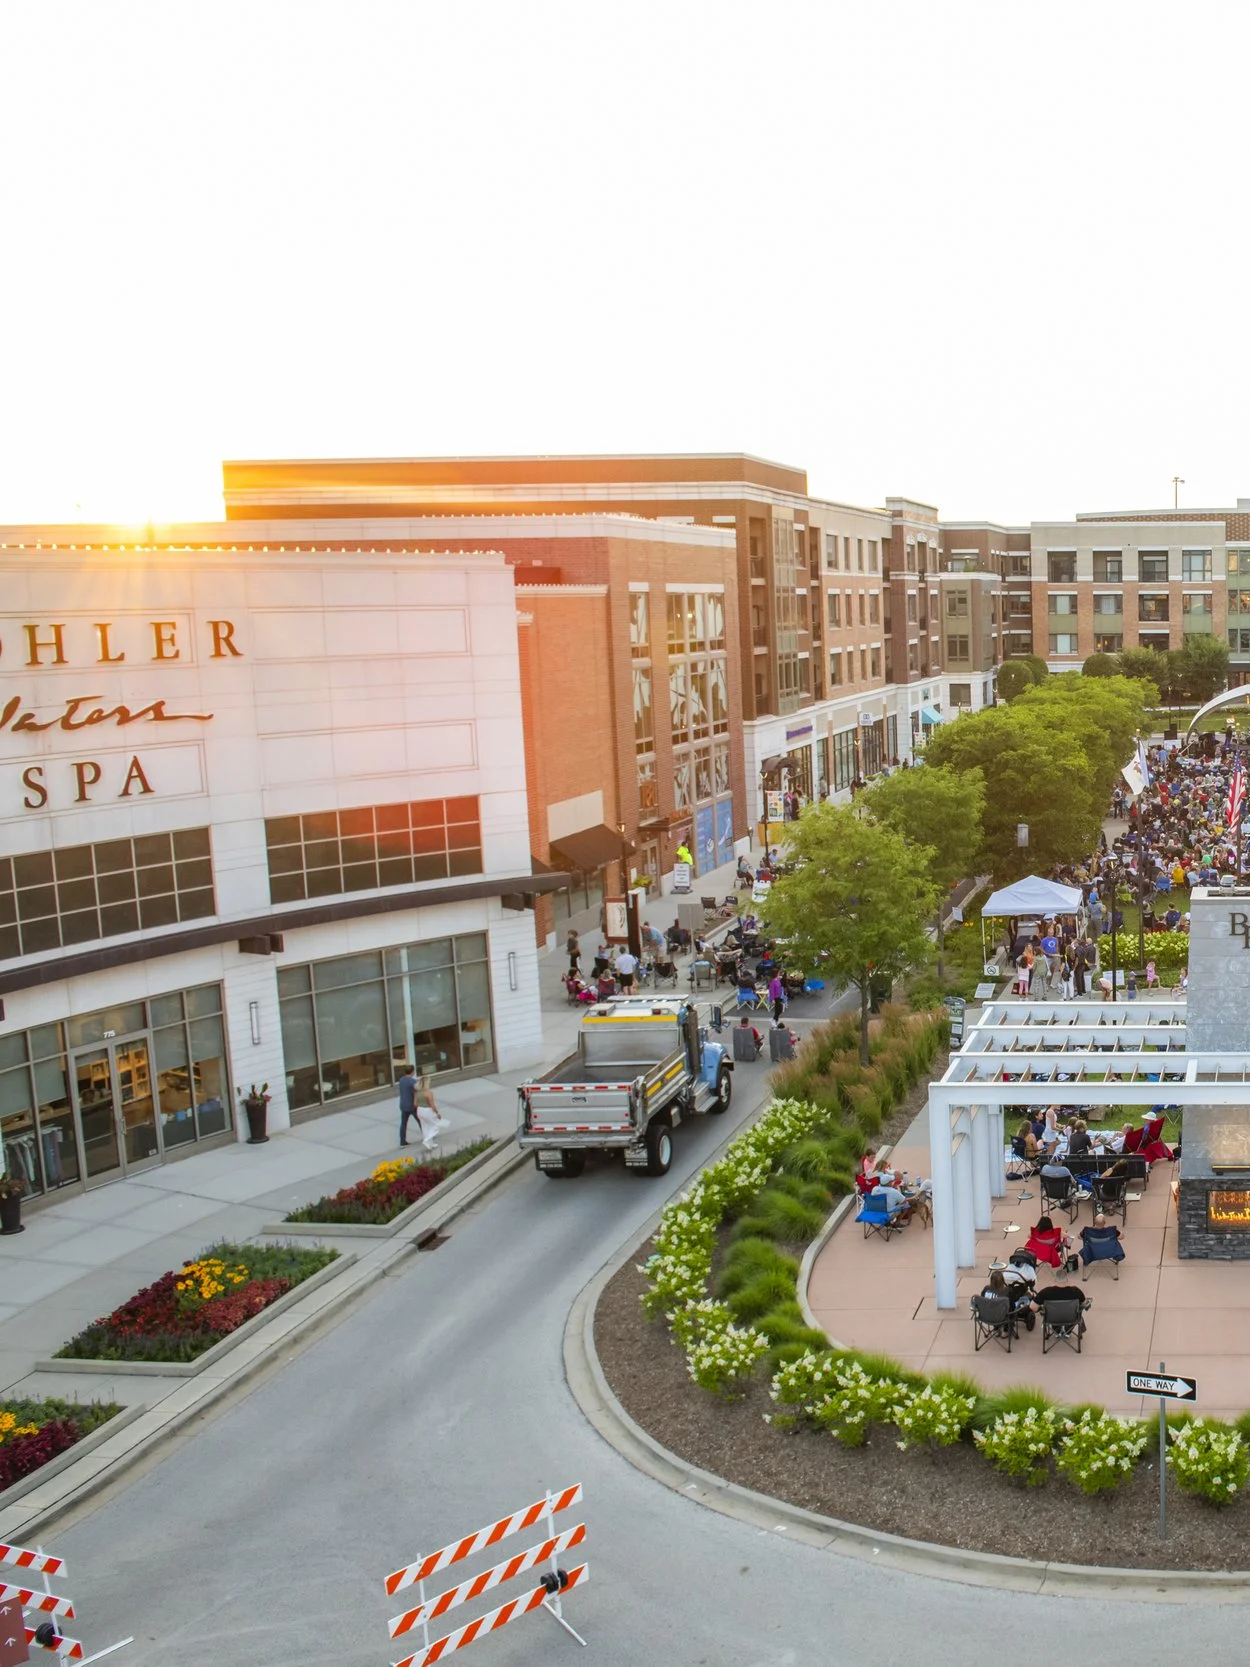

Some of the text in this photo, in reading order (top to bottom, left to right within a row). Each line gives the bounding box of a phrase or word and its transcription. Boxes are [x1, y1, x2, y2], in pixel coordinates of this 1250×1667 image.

[0, 620, 243, 665] HLER
[22, 755, 155, 809] SPA
[103, 1029, 116, 1038] 775
[1133, 1377, 1175, 1391] ONE WAY
